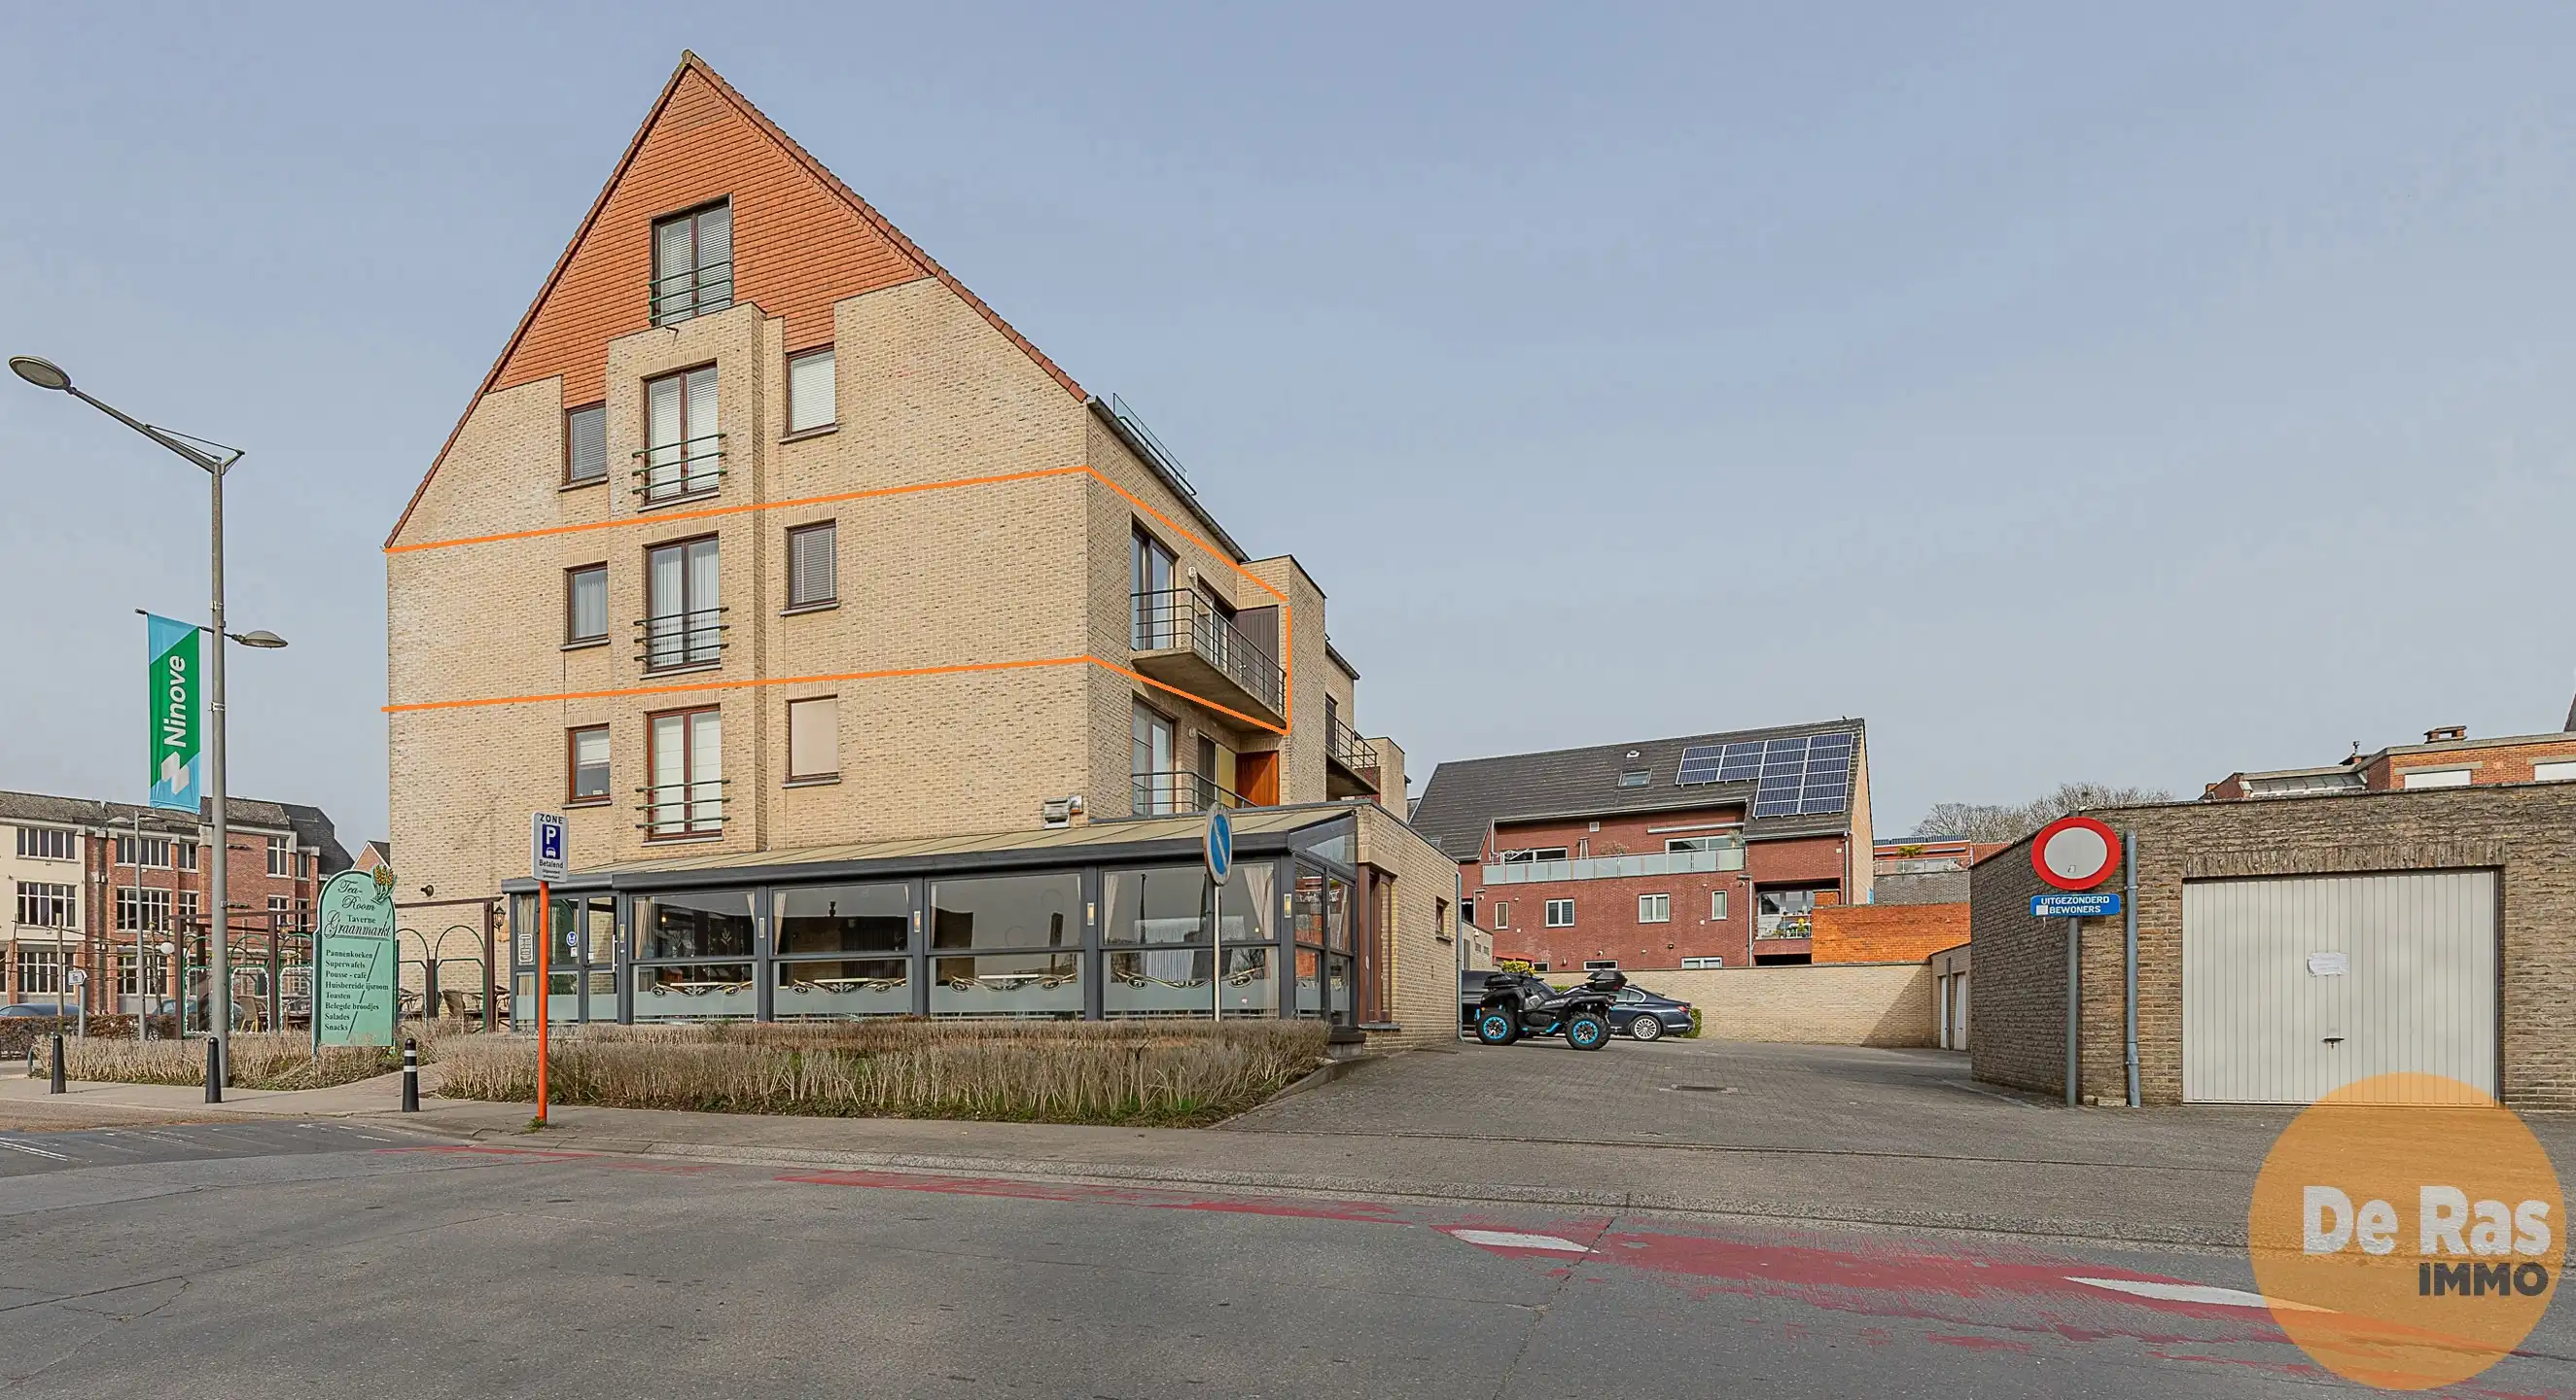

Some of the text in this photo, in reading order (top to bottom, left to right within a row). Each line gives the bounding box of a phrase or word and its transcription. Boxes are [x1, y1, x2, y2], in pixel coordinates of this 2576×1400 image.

[163, 655, 187, 748] Ninove
[540, 814, 563, 824] ZONE
[546, 825, 556, 845] P
[539, 859, 563, 869] Betalend
[337, 878, 363, 893] Tea-
[341, 895, 375, 911] Room
[2040, 895, 2110, 905] UITGEZONDERD
[324, 910, 391, 938] Graanmarkt
[346, 914, 376, 924] Taverne
[326, 949, 373, 959] Pannenkoeken
[325, 961, 366, 969] Superwafels
[325, 981, 389, 991] Huisbereide ijsroom
[325, 1002, 379, 1011] Belegde broodjes
[324, 1012, 350, 1021] Salades
